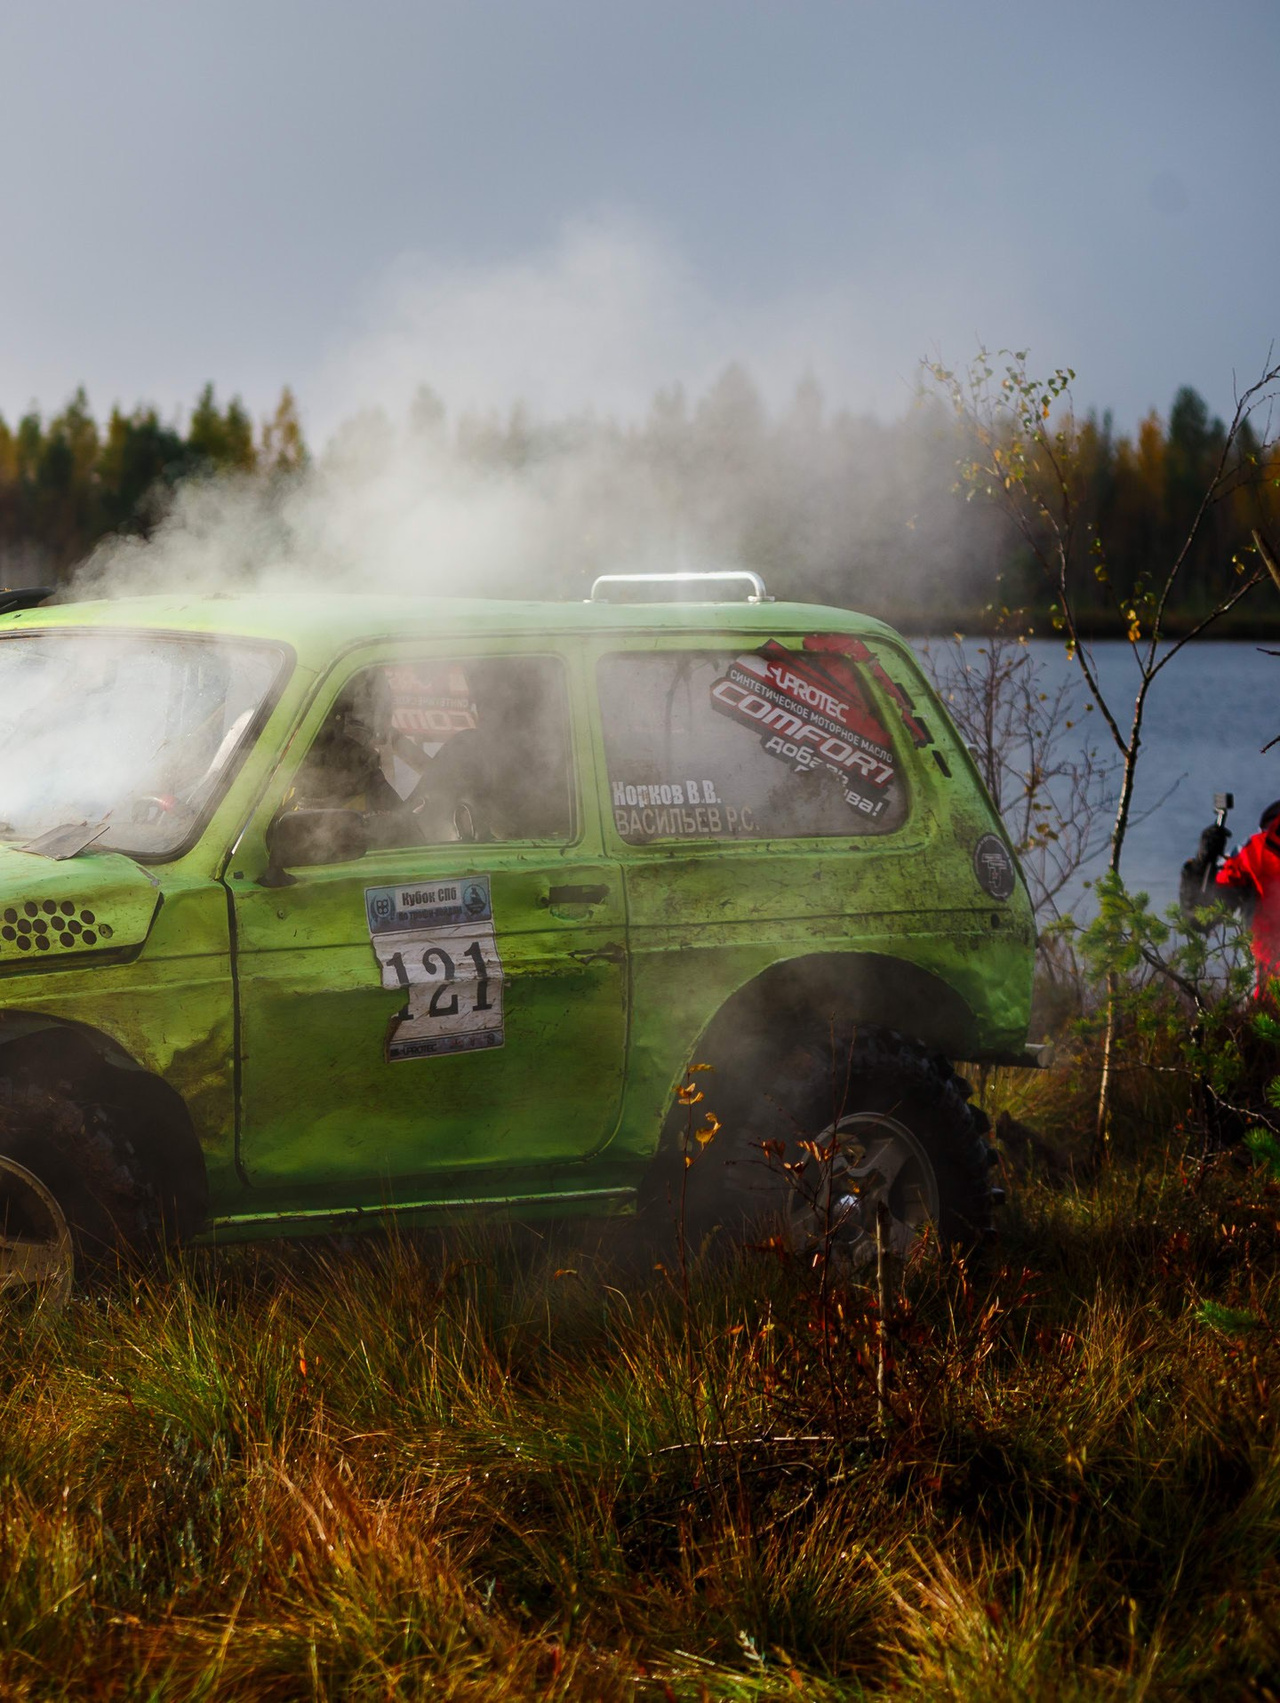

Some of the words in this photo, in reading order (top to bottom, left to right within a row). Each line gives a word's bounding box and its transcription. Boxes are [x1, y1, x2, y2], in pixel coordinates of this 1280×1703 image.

[712, 681, 894, 784] COMFORT
[730, 669, 809, 718] СИНТЕТИЧЕСКОЕ
[809, 713, 859, 746] МОТОРНОЕ
[860, 740, 893, 763] МАСЛО
[612, 781, 684, 807] Норков
[686, 780, 722, 804] В.В.
[615, 807, 722, 835] ВАСИЛЬЕВ
[725, 805, 760, 832] Р.С.
[401, 891, 435, 906] Кубок
[438, 887, 457, 902] СПб
[386, 941, 493, 1021] 121
